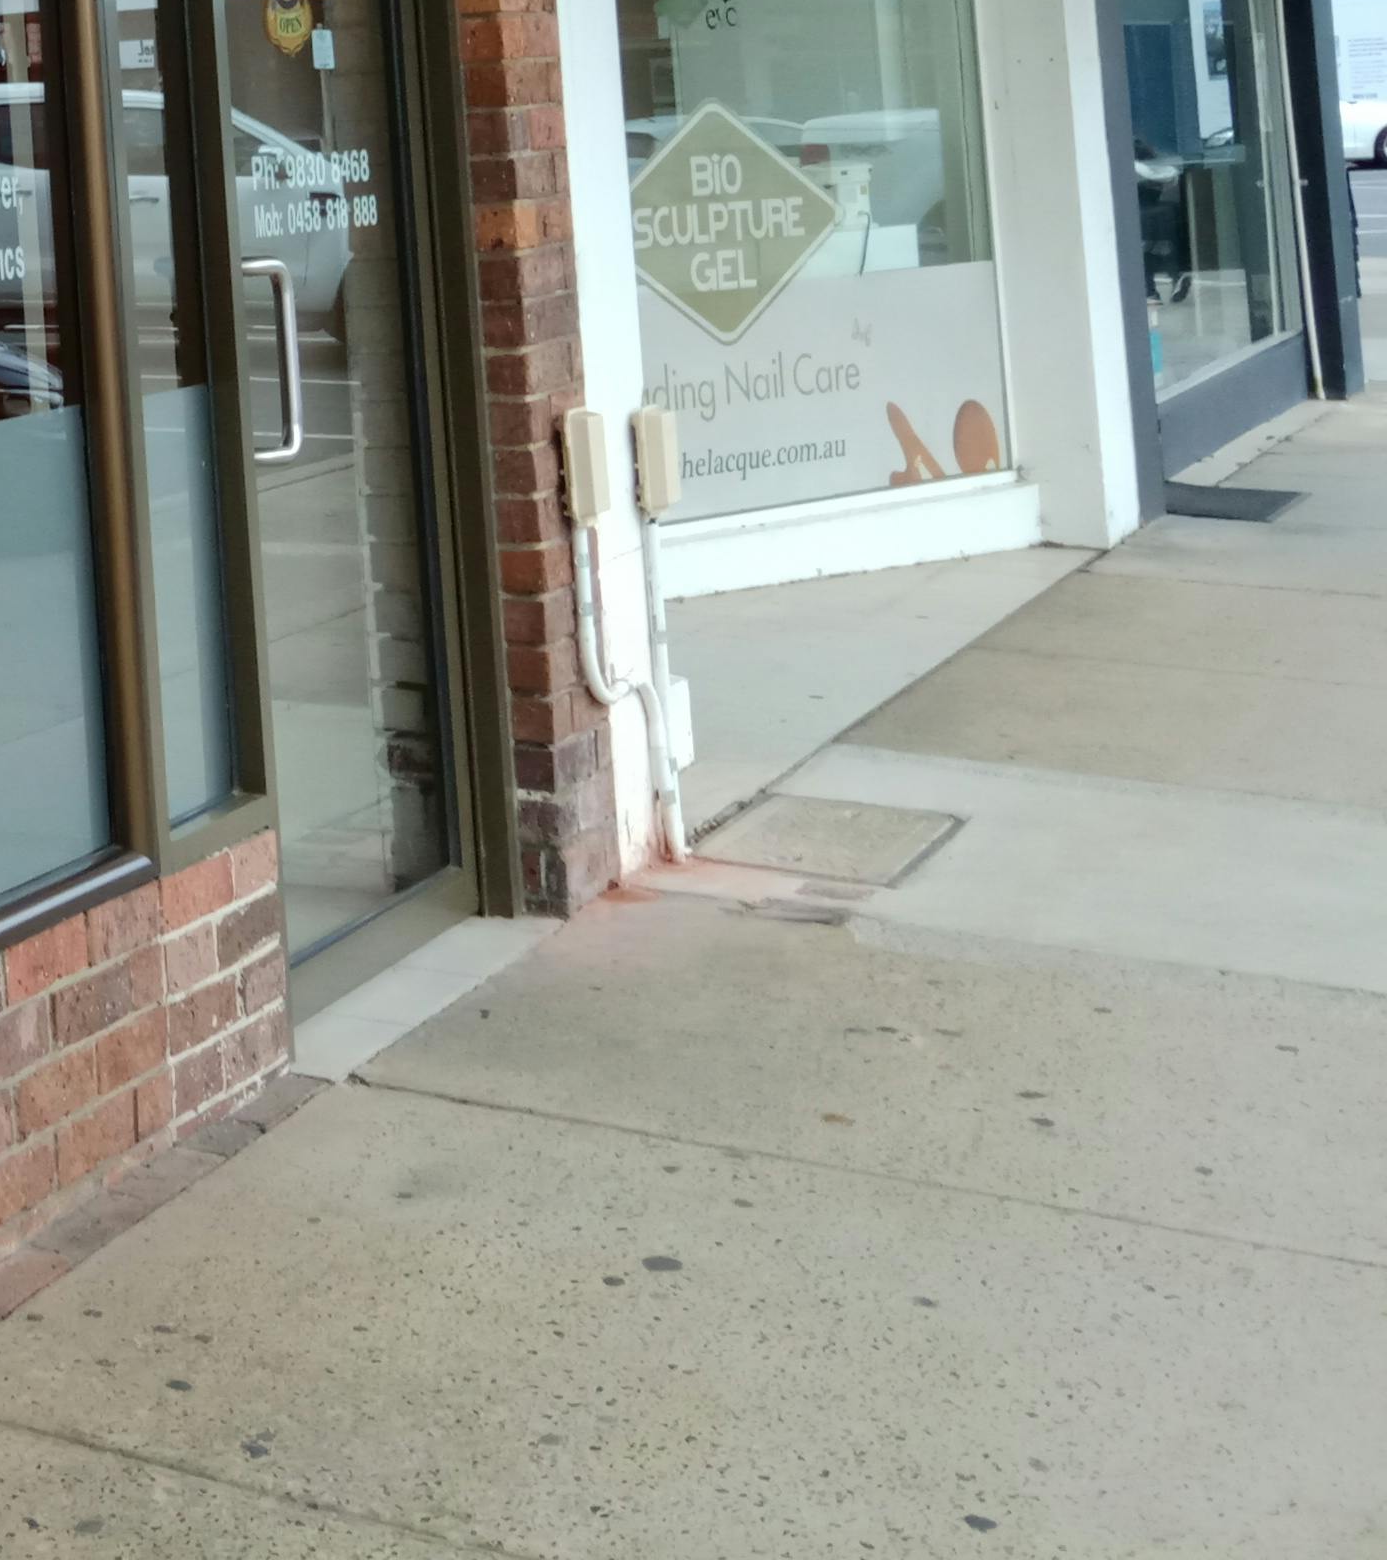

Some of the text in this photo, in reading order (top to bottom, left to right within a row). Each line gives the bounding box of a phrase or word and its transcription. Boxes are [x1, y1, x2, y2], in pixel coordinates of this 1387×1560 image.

[251, 148, 370, 191] Ph: 9830 8468
[254, 195, 377, 238] Mob: 0458 818 888
[633, 196, 805, 249] SCULPTURE
[690, 249, 758, 292] GEL
[724, 351, 785, 405] Nail
[793, 353, 861, 396] Care
